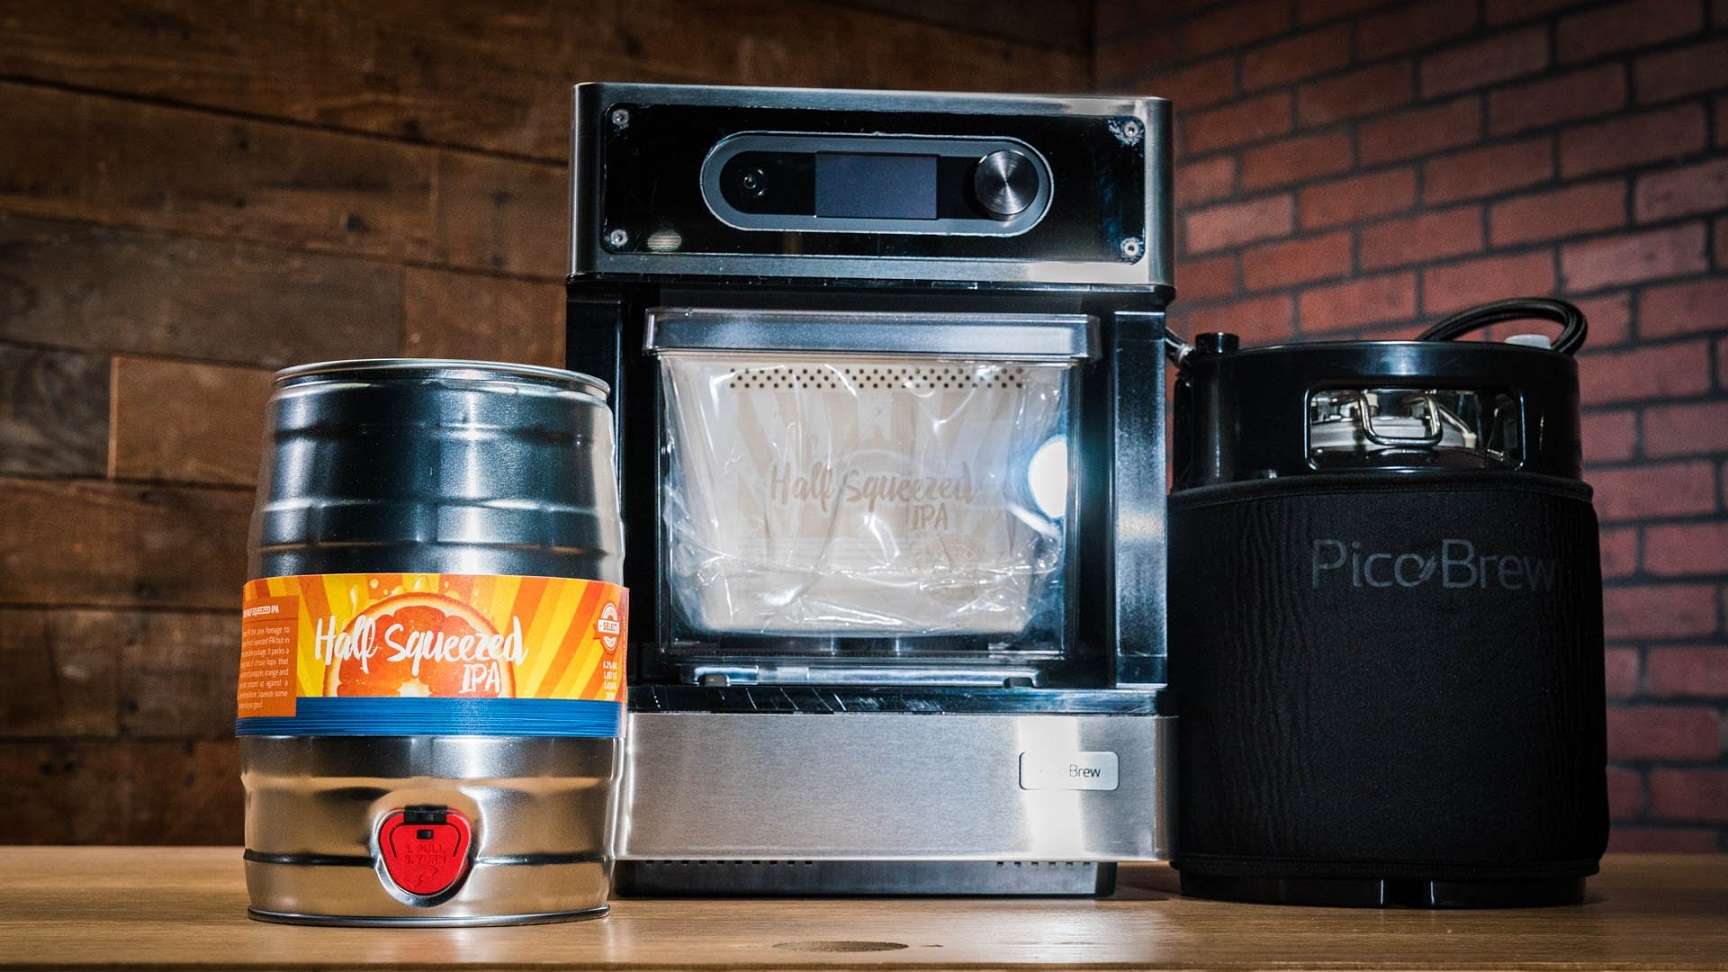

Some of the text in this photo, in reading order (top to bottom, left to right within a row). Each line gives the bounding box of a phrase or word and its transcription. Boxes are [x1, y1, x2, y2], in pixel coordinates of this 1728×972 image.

[770, 461, 976, 513] Half Squeezed
[911, 502, 949, 530] IPA
[1312, 538, 1557, 591] PicoBrew
[271, 604, 279, 614] IPA
[315, 615, 528, 677] Half Squeezed
[458, 661, 501, 694] IPA
[1069, 764, 1101, 778] Brew
